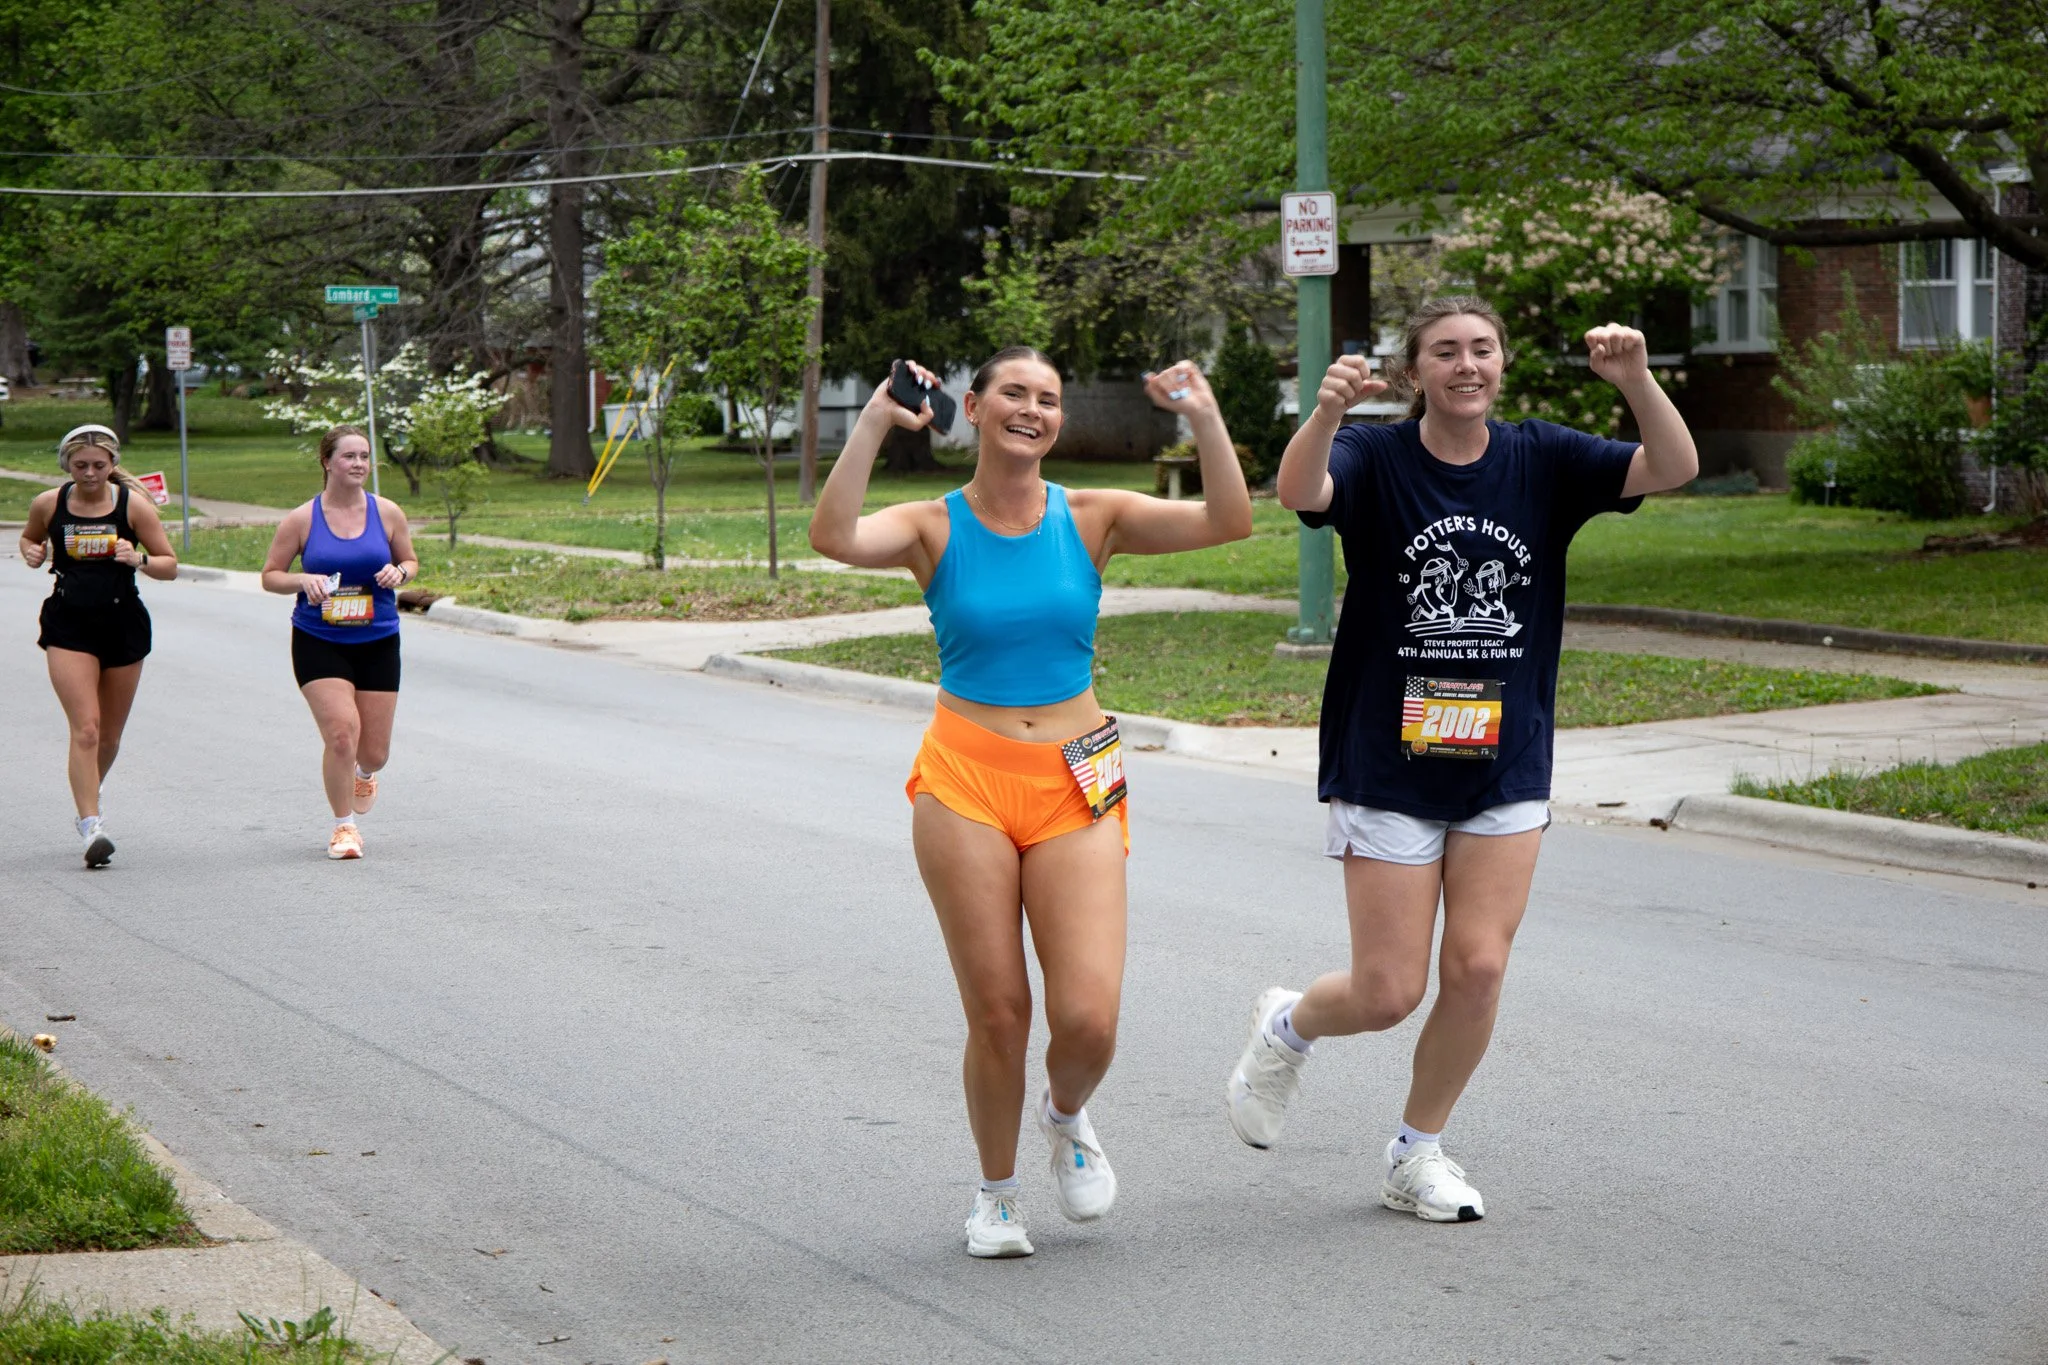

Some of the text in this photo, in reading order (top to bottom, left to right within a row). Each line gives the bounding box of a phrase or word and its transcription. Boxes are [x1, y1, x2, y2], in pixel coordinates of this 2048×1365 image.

[1298, 200, 1318, 216] NO
[1286, 217, 1332, 233] PARKING
[77, 537, 109, 555] 2193
[1404, 516, 1532, 568] POTTER'S HOUSE
[1398, 572, 1410, 584] 20
[331, 599, 368, 618] 2090
[1423, 639, 1505, 647] STEVE PROFFITT LEGACY
[1398, 647, 1524, 659] 4TH ANNUAL 5K & FUN RU
[1420, 705, 1491, 740] 2002
[1095, 747, 1122, 794] 202
